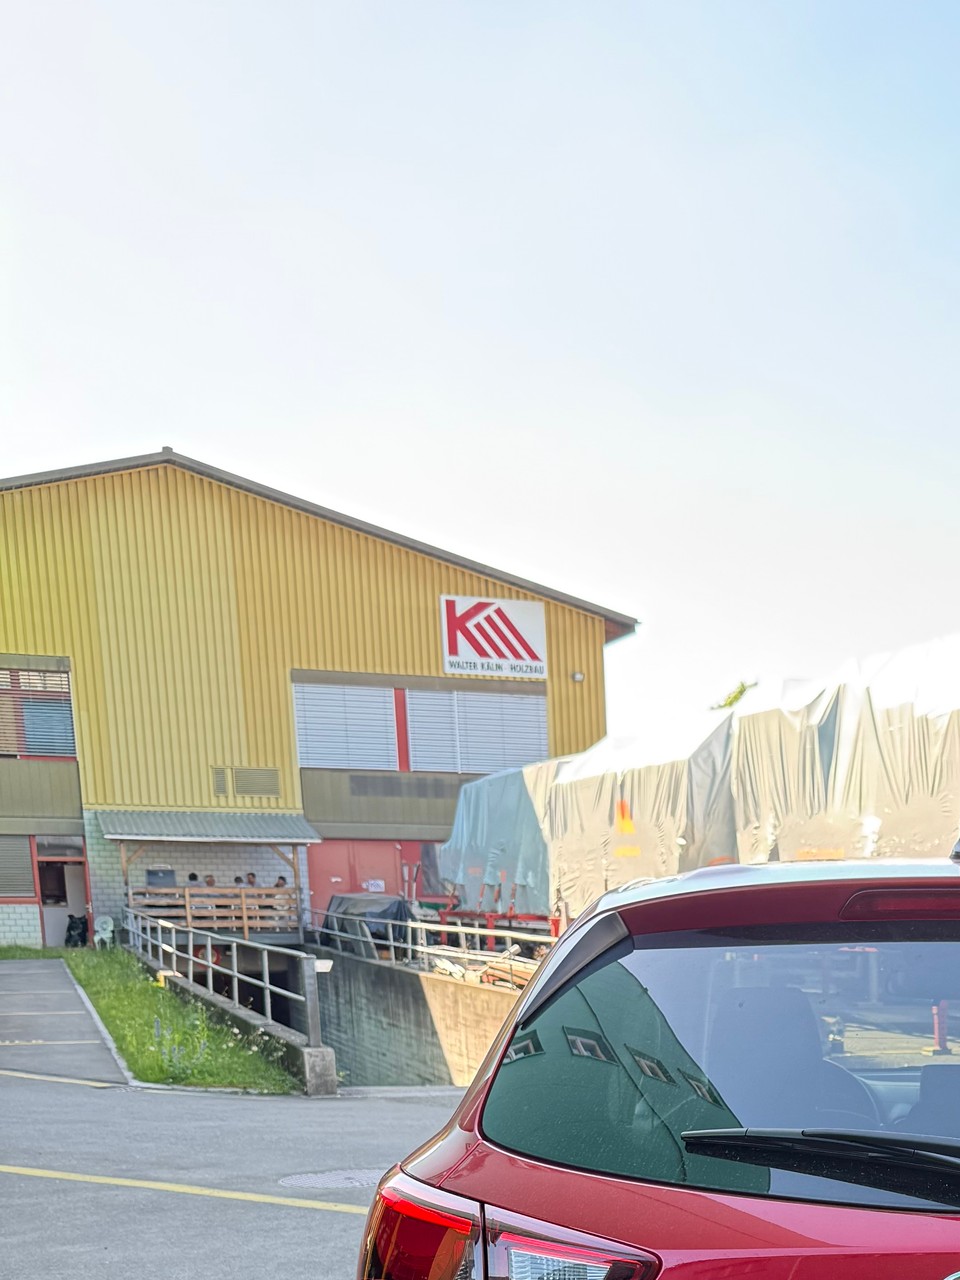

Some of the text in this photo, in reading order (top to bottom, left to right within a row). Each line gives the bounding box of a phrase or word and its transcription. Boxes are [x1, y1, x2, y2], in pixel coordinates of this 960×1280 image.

[448, 660, 545, 674] WALTER KÄLIN HOLZBAU
